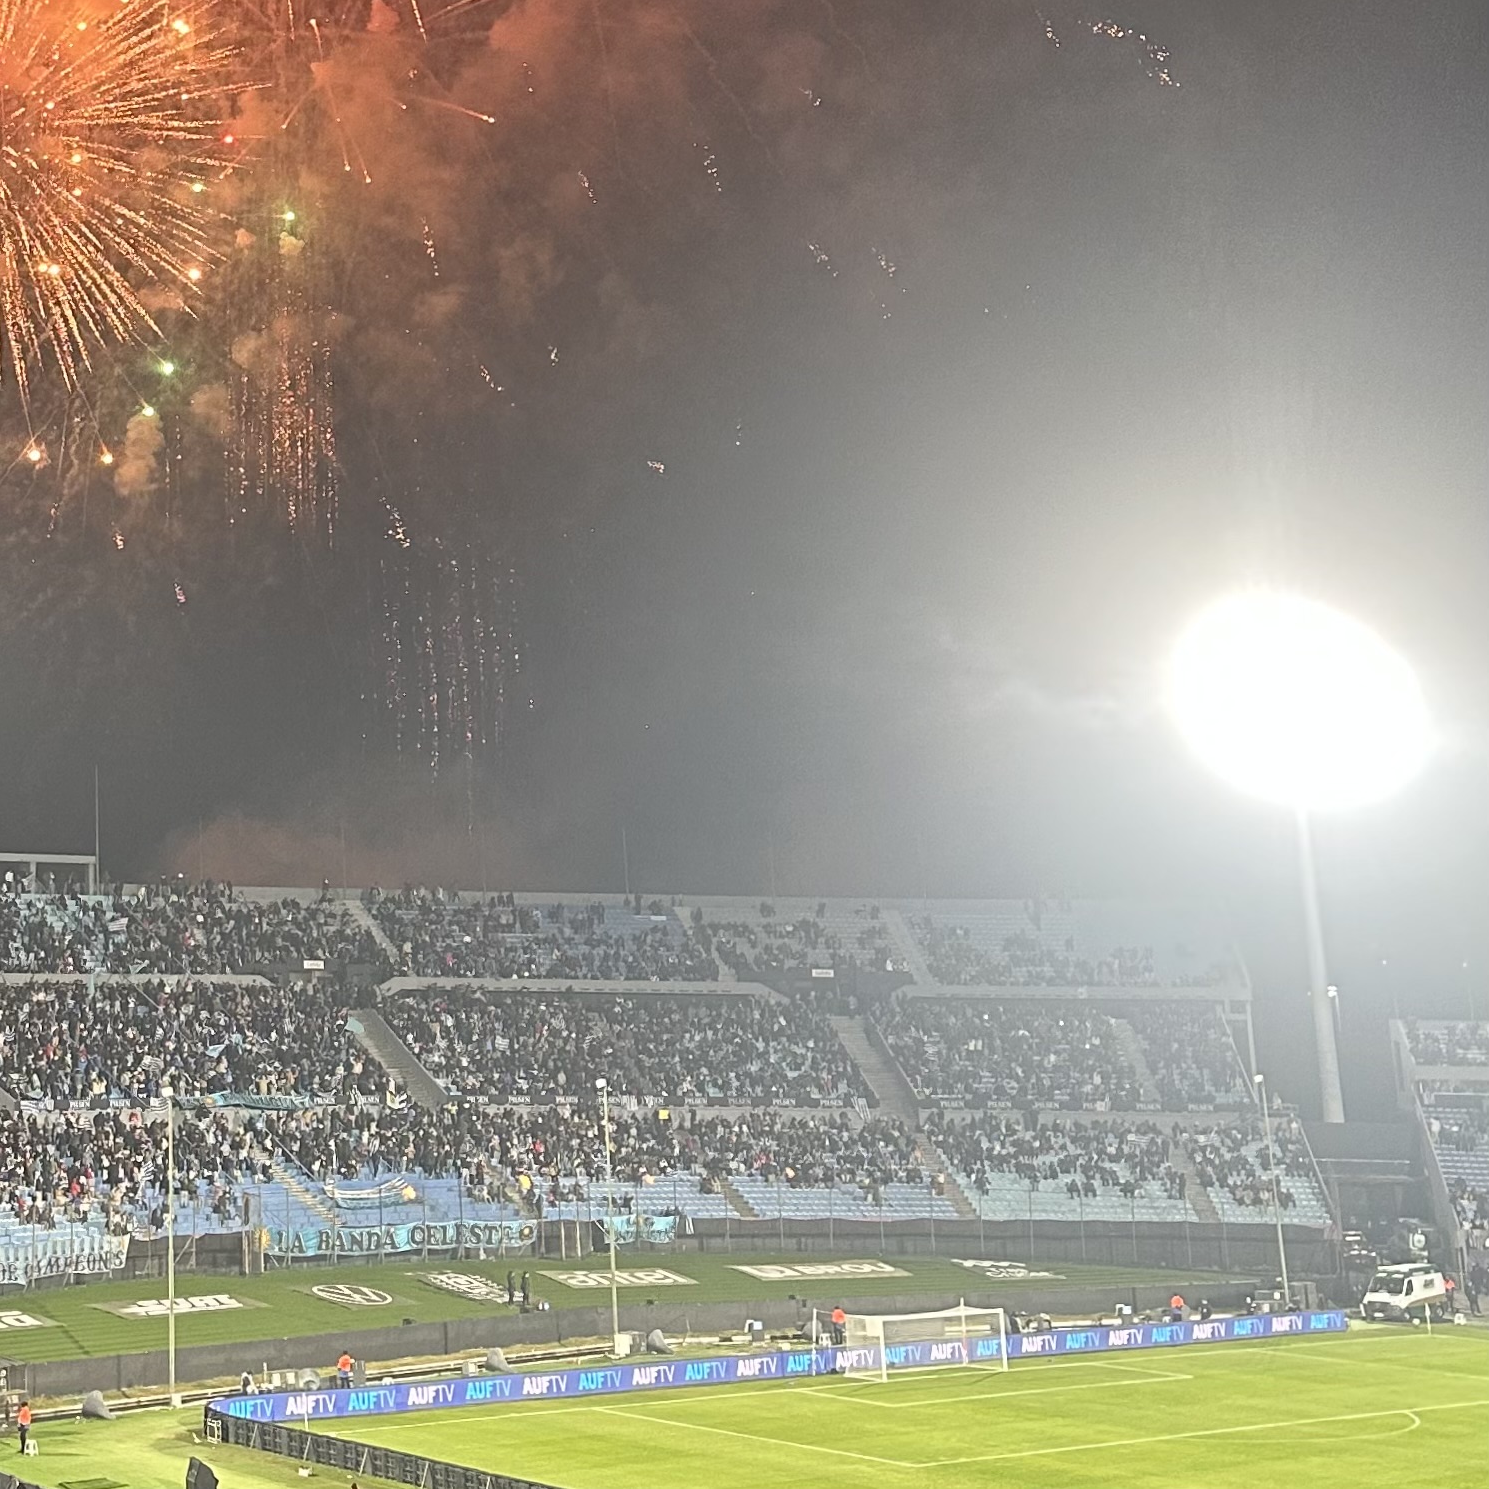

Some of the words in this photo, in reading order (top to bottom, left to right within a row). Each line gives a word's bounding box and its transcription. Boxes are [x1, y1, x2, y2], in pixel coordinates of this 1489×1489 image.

[278, 1230, 306, 1253] LA
[318, 1228, 400, 1252] BANDA
[410, 1223, 514, 1246] CELESTE
[558, 1269, 688, 1286] antel
[792, 1262, 896, 1274] BROU
[229, 1399, 273, 1418] AUFTV
[286, 1394, 335, 1415] AUFTV
[349, 1390, 396, 1410] AUFTV
[408, 1384, 454, 1405] AUFTV
[466, 1380, 511, 1399] AUFTV
[523, 1375, 567, 1395] AUFTV
[579, 1370, 621, 1390] AUFTV
[632, 1365, 674, 1385] AUFTV
[685, 1361, 726, 1380] AUFTV
[737, 1357, 777, 1377] AUFTV
[836, 1350, 874, 1371] AUFTV
[1022, 1335, 1057, 1353] AUFTV
[1066, 1332, 1100, 1349] AUFTV
[1109, 1329, 1143, 1346] AUFTV
[1152, 1326, 1185, 1342] AUFTV
[1192, 1322, 1226, 1340] AUFTV
[1233, 1318, 1264, 1335] AUFTV
[1272, 1315, 1302, 1332] AUFTV
[1310, 1313, 1341, 1329] AUFTV
